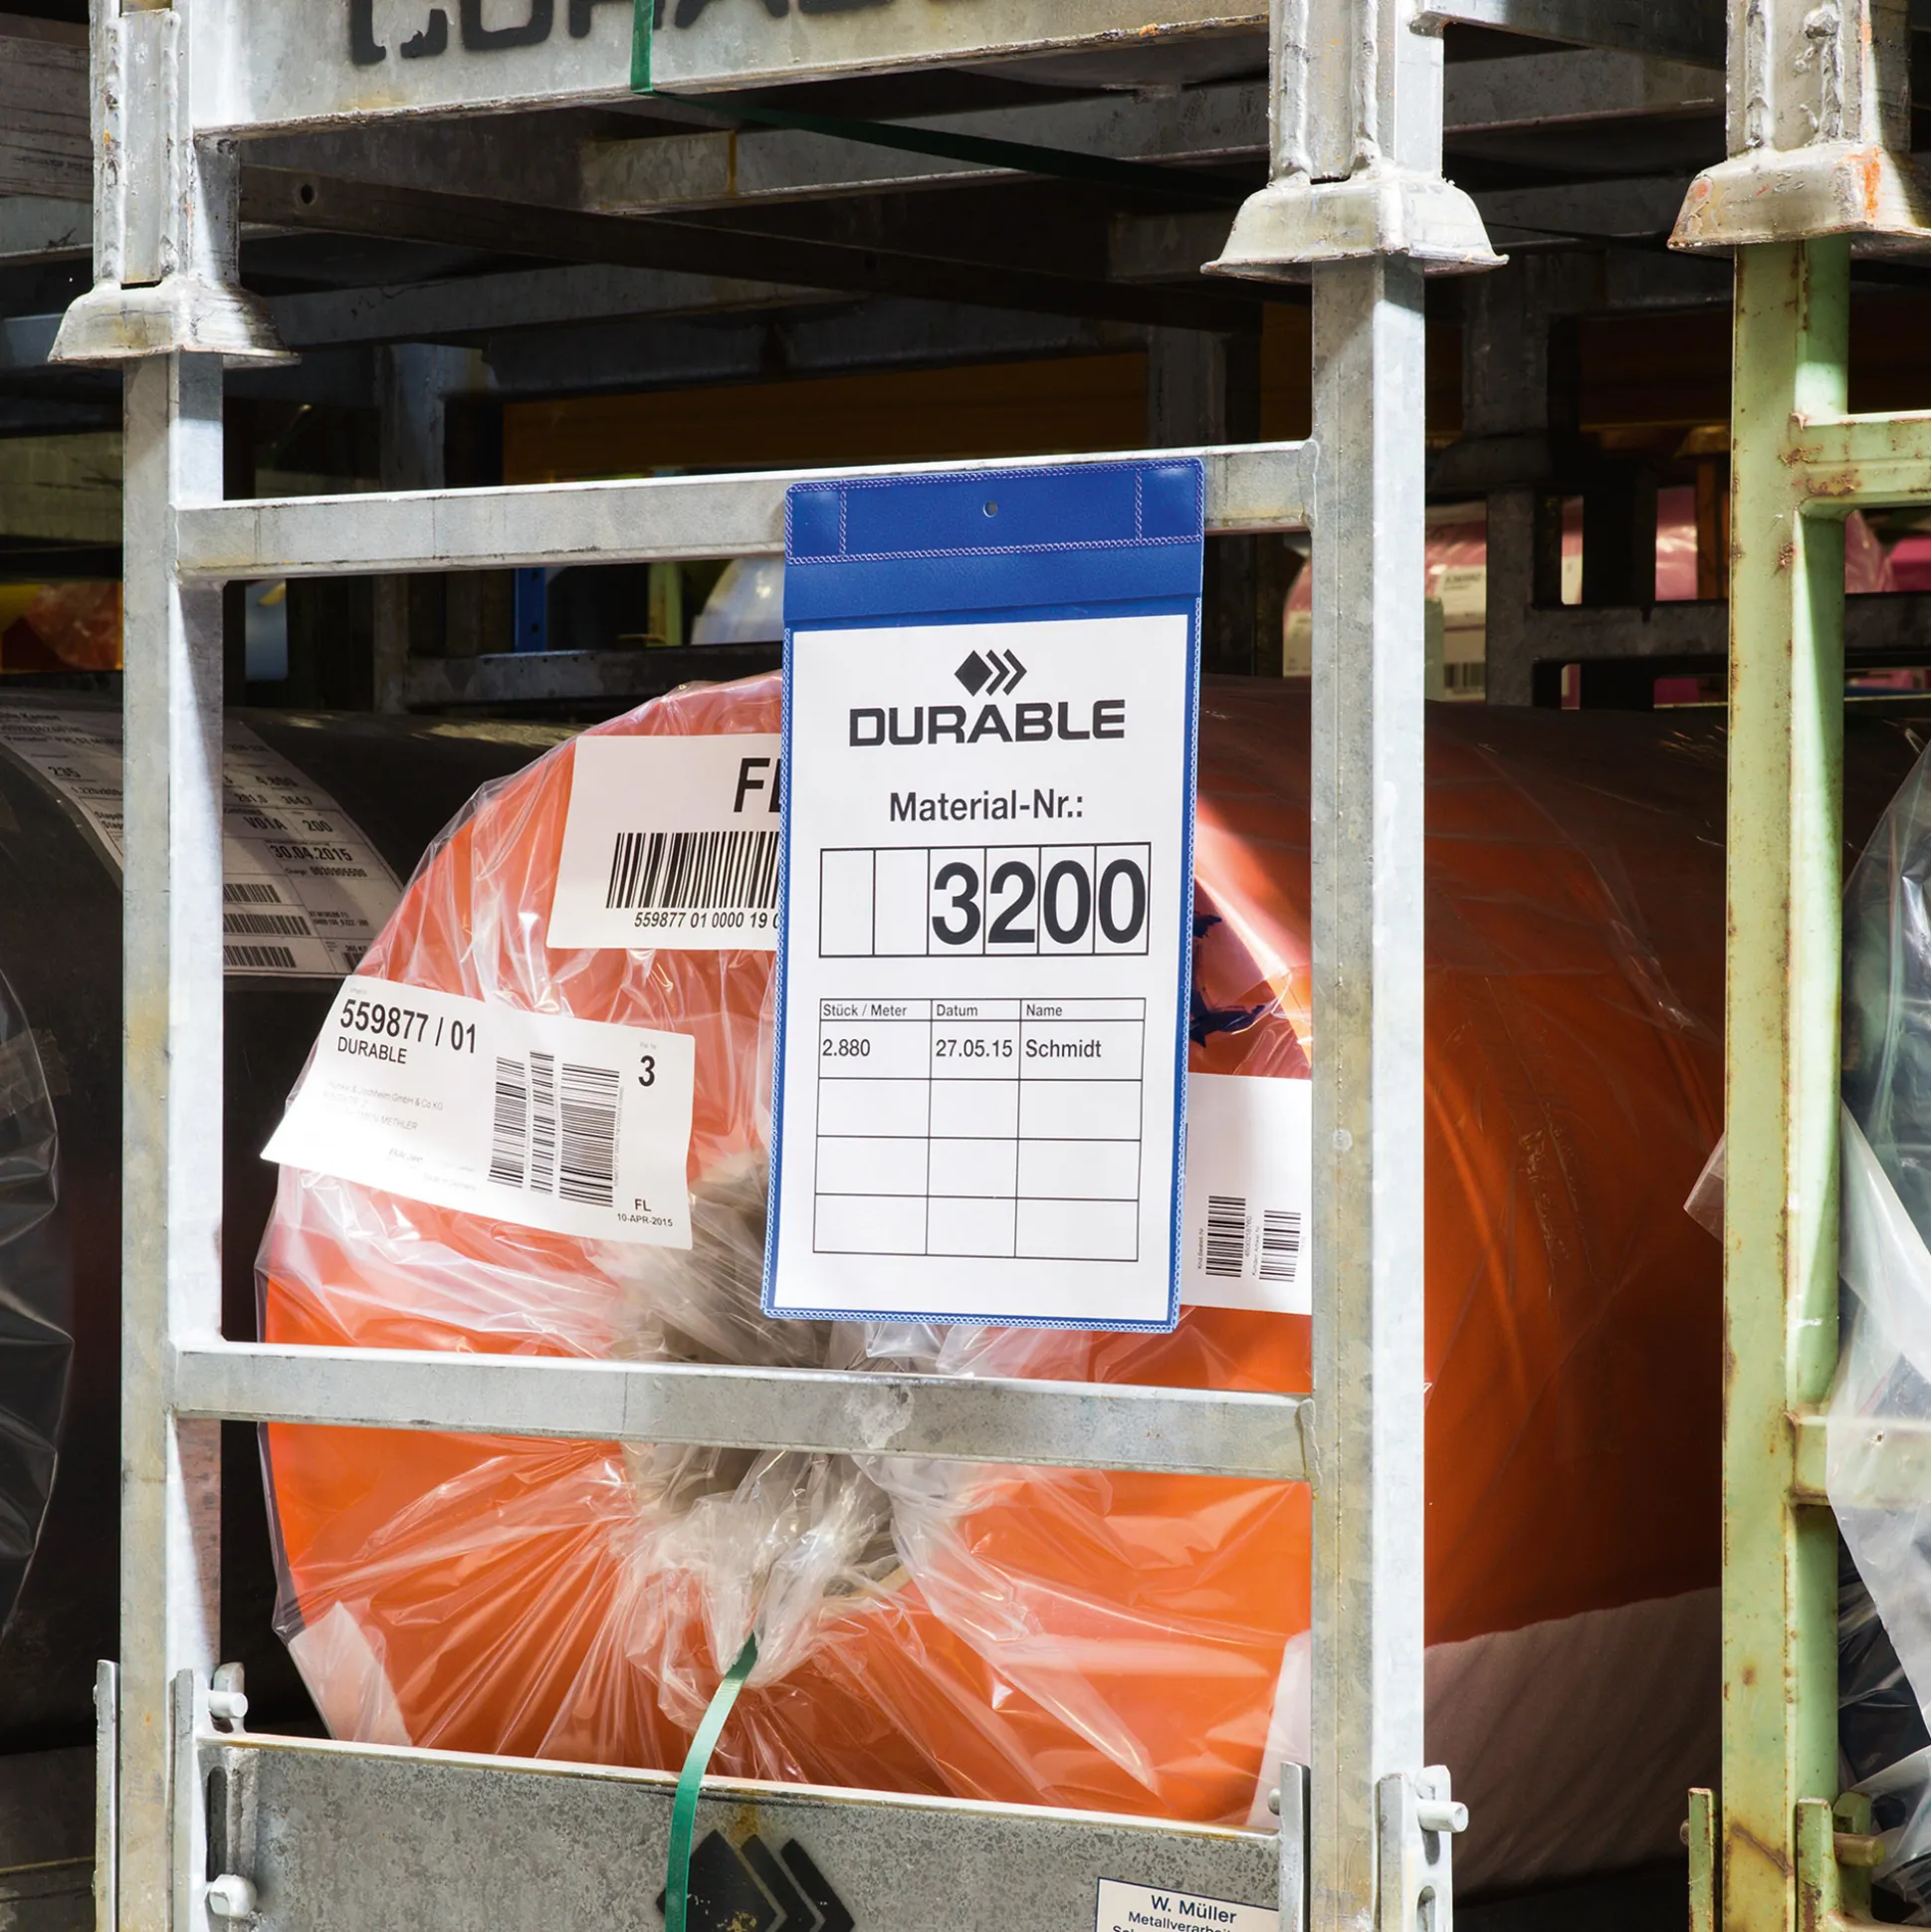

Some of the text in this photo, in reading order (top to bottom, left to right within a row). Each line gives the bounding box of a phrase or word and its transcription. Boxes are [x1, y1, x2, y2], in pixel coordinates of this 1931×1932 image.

[848, 699, 1126, 747] DURABLE
[889, 788, 1084, 822] Material-Nr.:
[302, 819, 333, 833] 200
[270, 845, 353, 862] 30.04.2015
[931, 858, 1147, 946] 3200
[634, 912, 687, 928] 559877
[689, 912, 707, 928] 01
[712, 912, 745, 928] 0000
[750, 913, 767, 928] 19
[823, 1003, 859, 1017] Stück
[871, 1003, 907, 1016] Meter
[937, 1003, 978, 1016] Datum
[1026, 1003, 1063, 1016] Name
[340, 998, 429, 1042] 559877
[451, 1020, 476, 1054] 01
[337, 1035, 407, 1064] DURABLE
[822, 1038, 871, 1057] 2.880
[936, 1039, 1012, 1057] 27.05.15
[1025, 1038, 1102, 1058] Schmidt
[638, 1055, 656, 1087] 3
[634, 1198, 652, 1212] FL
[616, 1212, 673, 1227] 10-APR-2015
[1151, 1894, 1237, 1924] W. Müller
